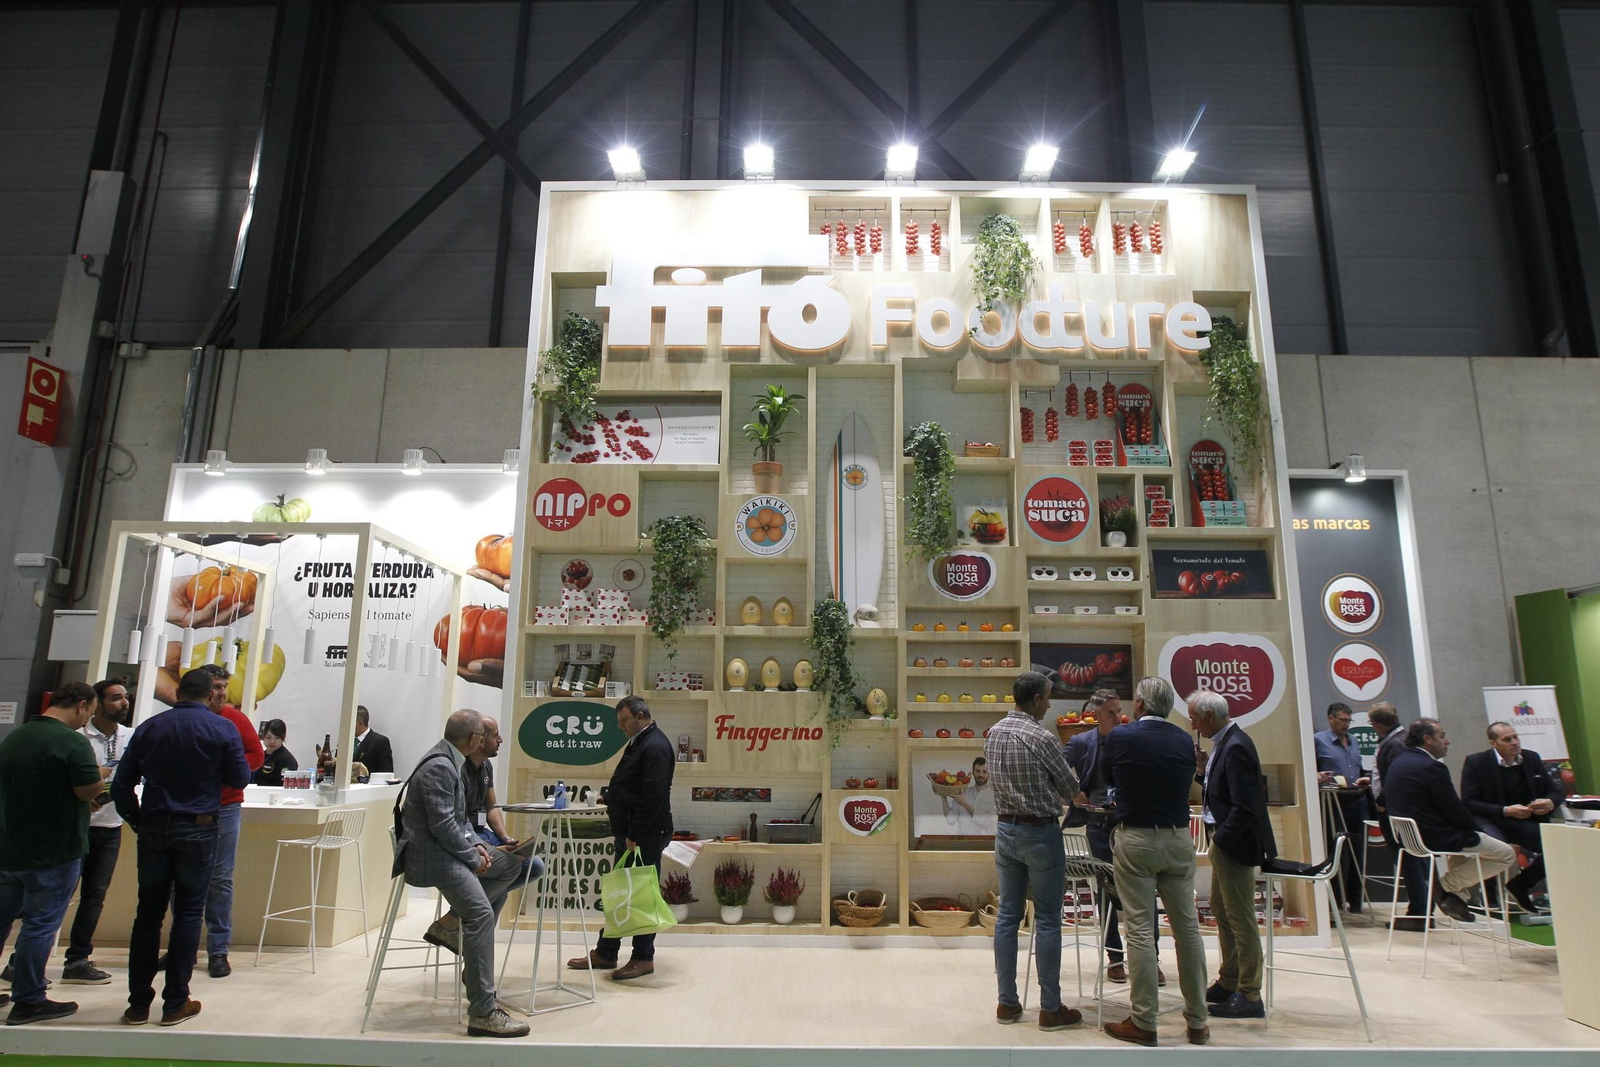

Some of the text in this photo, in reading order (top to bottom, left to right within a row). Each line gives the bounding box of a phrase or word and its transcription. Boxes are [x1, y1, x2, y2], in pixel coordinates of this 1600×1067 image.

[742, 498, 790, 515] WAIKIKI
[1027, 497, 1086, 509] tomacó
[1028, 508, 1087, 522] suca
[547, 518, 570, 528] トマト
[1313, 519, 1371, 530] marcas
[371, 563, 434, 579] ERDURA
[946, 563, 978, 572] Monte
[308, 583, 417, 599] U HORALIZA?
[1339, 597, 1365, 605] Monte
[308, 609, 350, 621] Sapiens
[374, 610, 412, 620] tomate
[1195, 659, 1250, 675] Monte
[546, 715, 604, 736] CRÜ
[714, 715, 823, 752] Finggerino
[546, 739, 603, 748] eat it raw
[564, 842, 615, 855] MISMO
